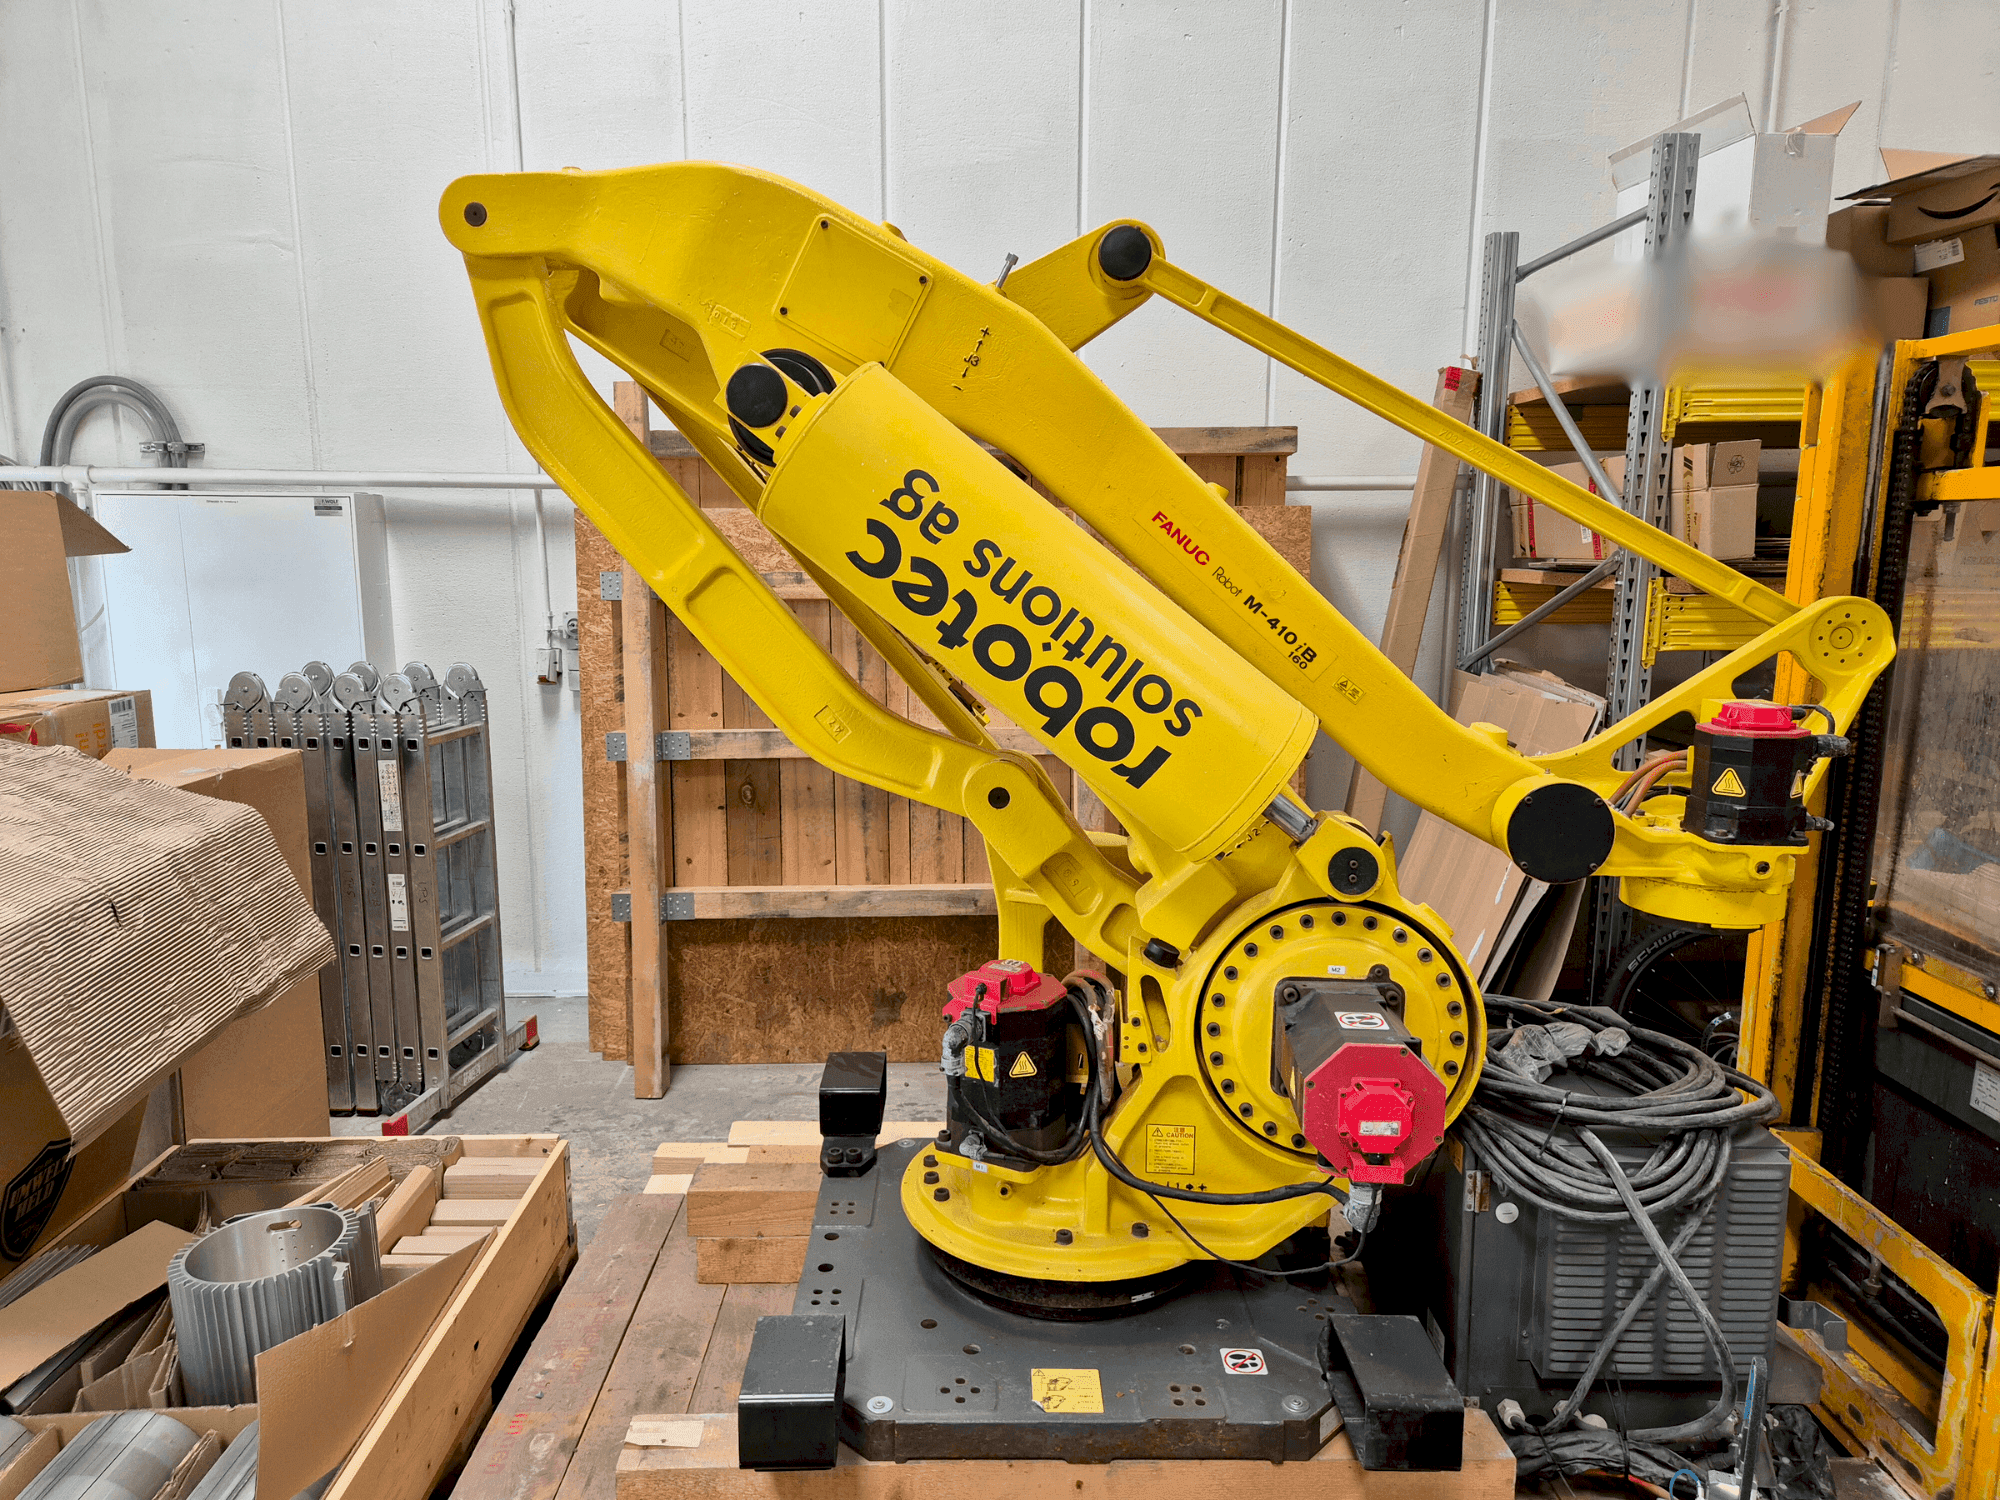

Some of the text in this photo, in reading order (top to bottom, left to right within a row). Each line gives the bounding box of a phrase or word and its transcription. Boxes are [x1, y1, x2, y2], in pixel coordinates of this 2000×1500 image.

[879, 469, 1203, 737] solutions ag
[1151, 511, 1210, 566] FANUC
[1212, 566, 1243, 597] Robot
[845, 518, 1172, 789] robotec
[1288, 650, 1309, 670] 160
